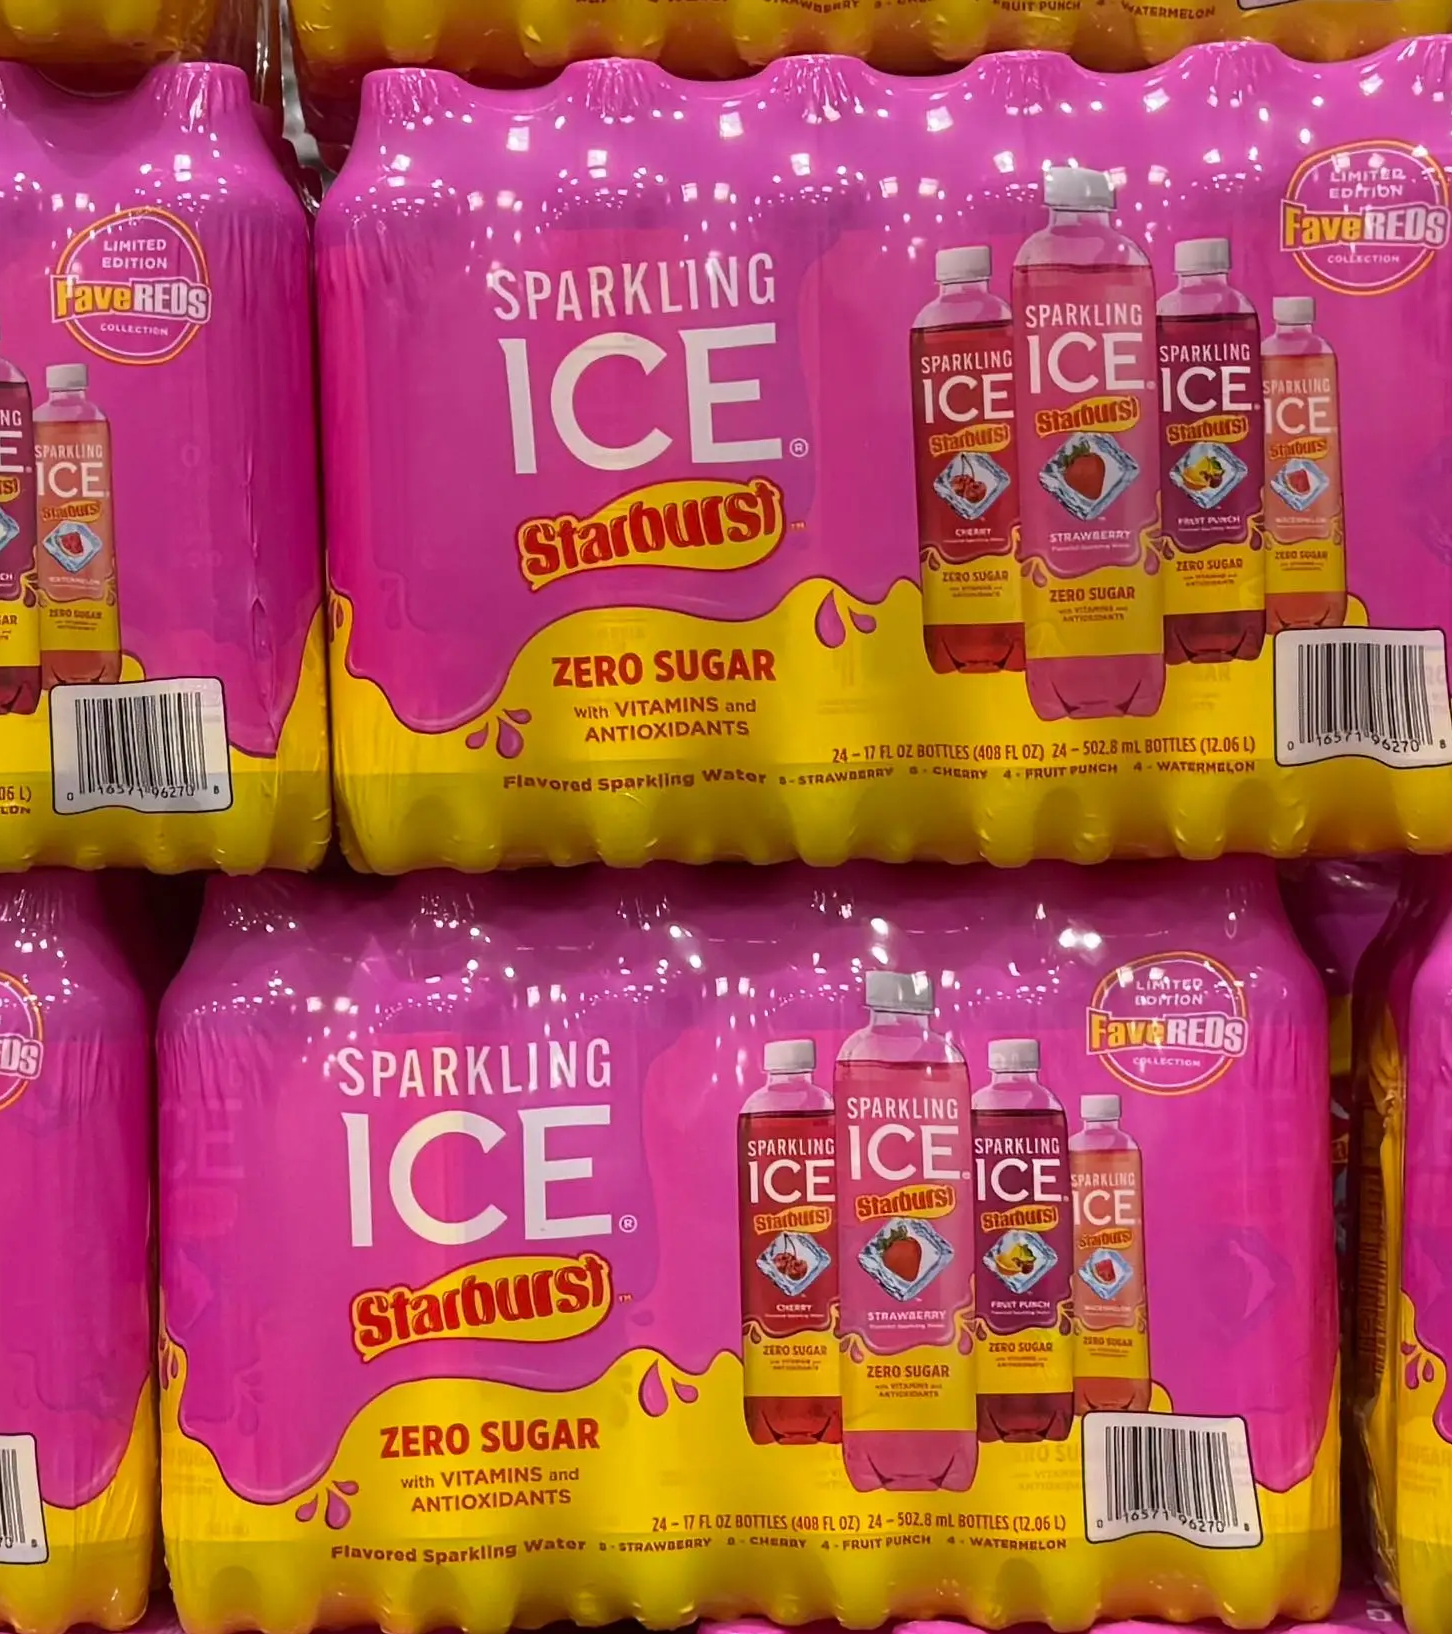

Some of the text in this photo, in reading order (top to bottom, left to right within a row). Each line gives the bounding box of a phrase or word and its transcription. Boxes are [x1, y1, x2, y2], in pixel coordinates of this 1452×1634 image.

[103, 240, 167, 252] LIMITED
[101, 257, 168, 270] EDITION
[486, 250, 774, 321] SPARKLING
[100, 324, 169, 336] COLLECTION
[522, 483, 781, 576] Starburst
[552, 649, 775, 688] ZERO SUGAR
[577, 697, 755, 719] with VITAMINS and
[586, 720, 749, 742] ANTIOXIDANTS
[833, 736, 1255, 763] 24 17 FL OZ BOTTLES (408 FL OZ) 24 502.8 mL BOTTLES (12.06 L)
[329, 1039, 610, 1097] SPARKLING
[356, 1257, 609, 1347] Starburst
[381, 1418, 599, 1458] ZERO SUGAR
[403, 1467, 578, 1489] with VITAMINS and
[412, 1489, 571, 1512] ANTIOXIDANTS
